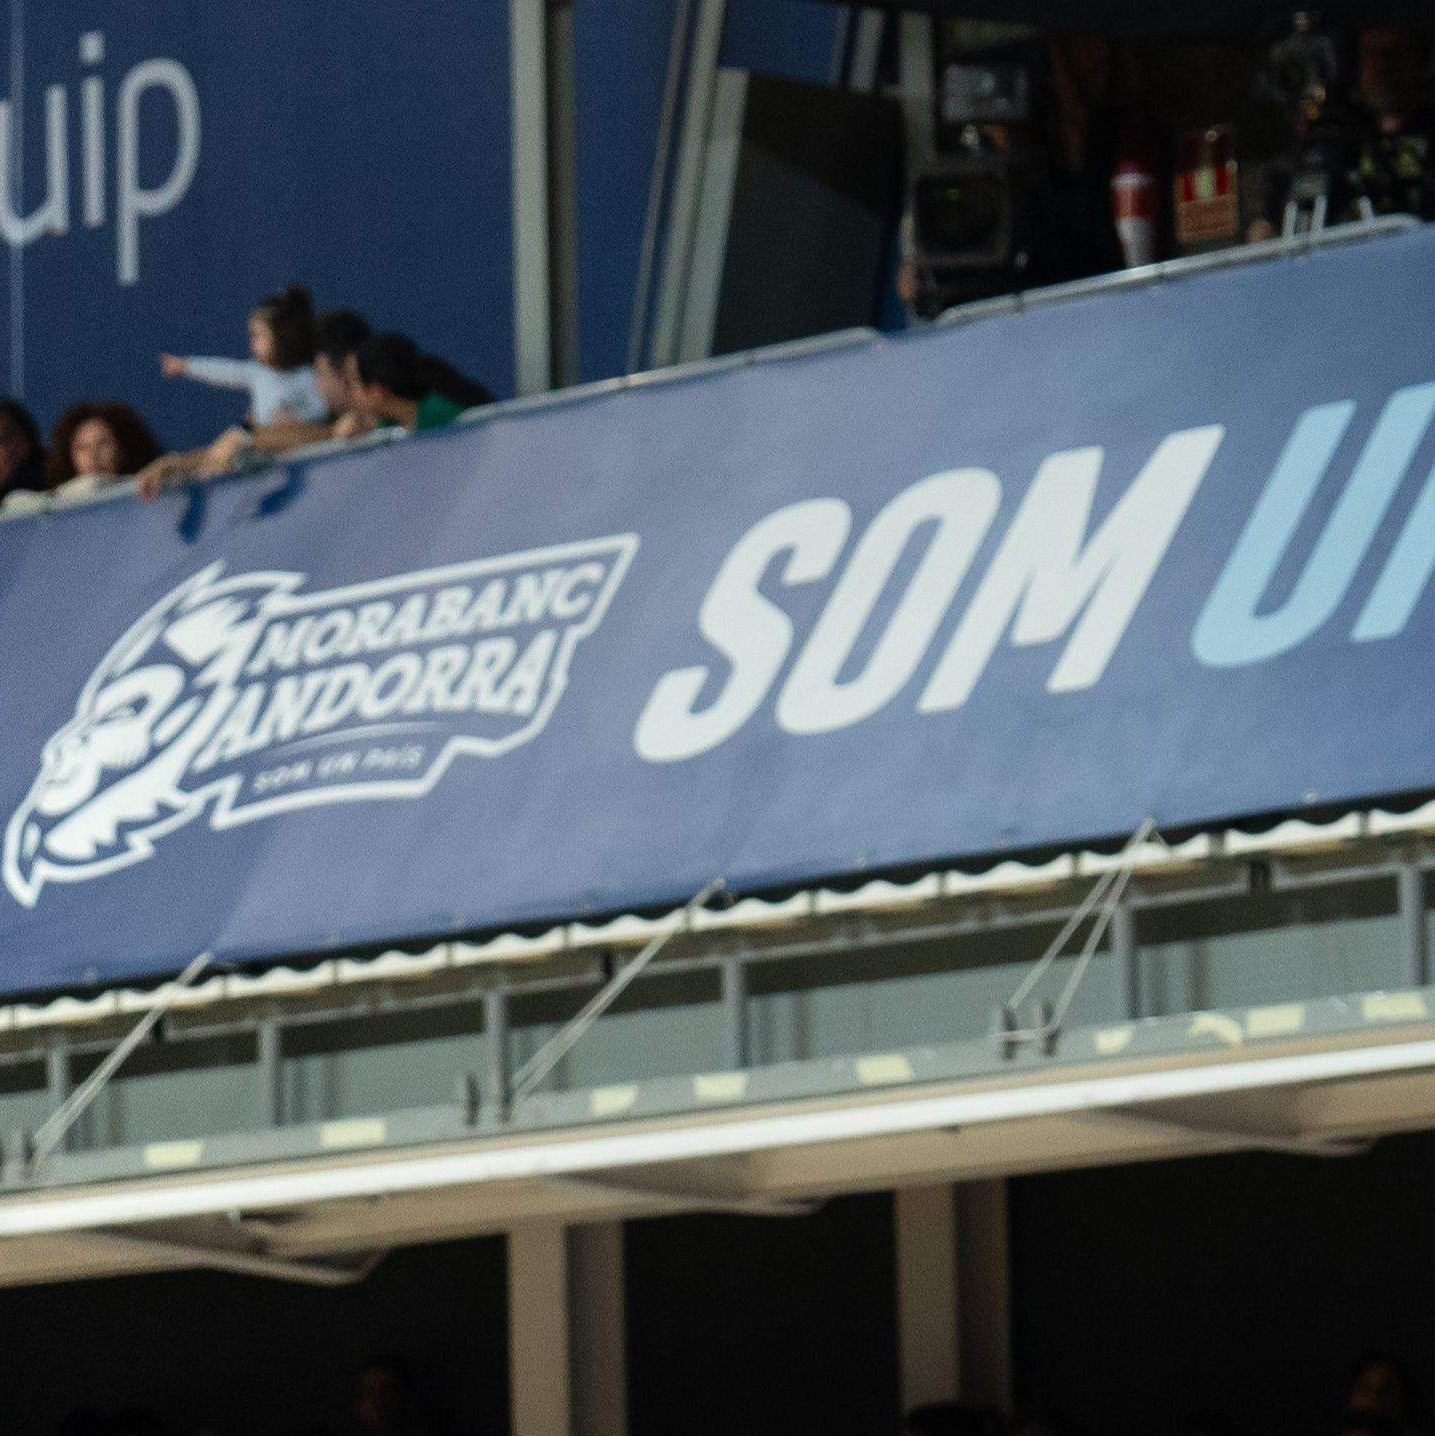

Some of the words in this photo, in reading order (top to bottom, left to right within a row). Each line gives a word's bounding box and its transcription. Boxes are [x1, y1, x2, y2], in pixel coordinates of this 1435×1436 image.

[247, 562, 605, 676] MORABANC
[634, 425, 1225, 762] SOM
[191, 628, 559, 775] ANDORRA
